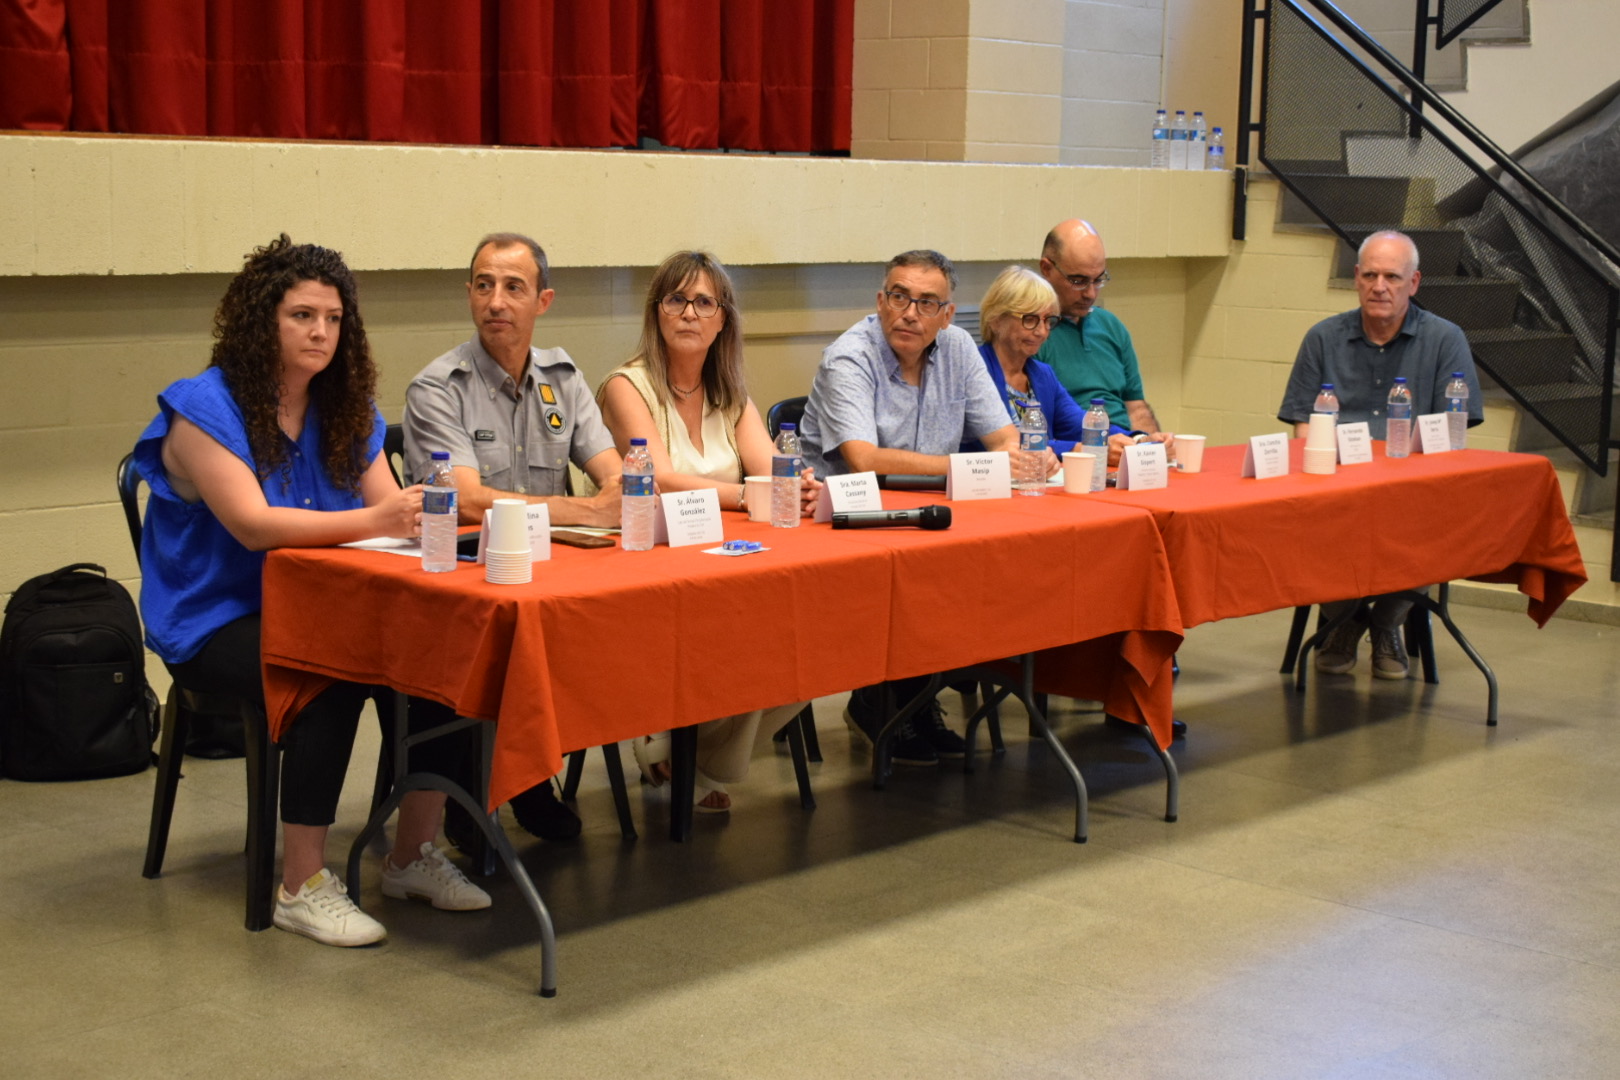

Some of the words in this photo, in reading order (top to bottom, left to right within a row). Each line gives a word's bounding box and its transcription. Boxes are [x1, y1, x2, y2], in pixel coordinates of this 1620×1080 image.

[971, 467, 990, 475] Masip
[686, 496, 705, 505] Álvaro
[680, 507, 706, 516] González
